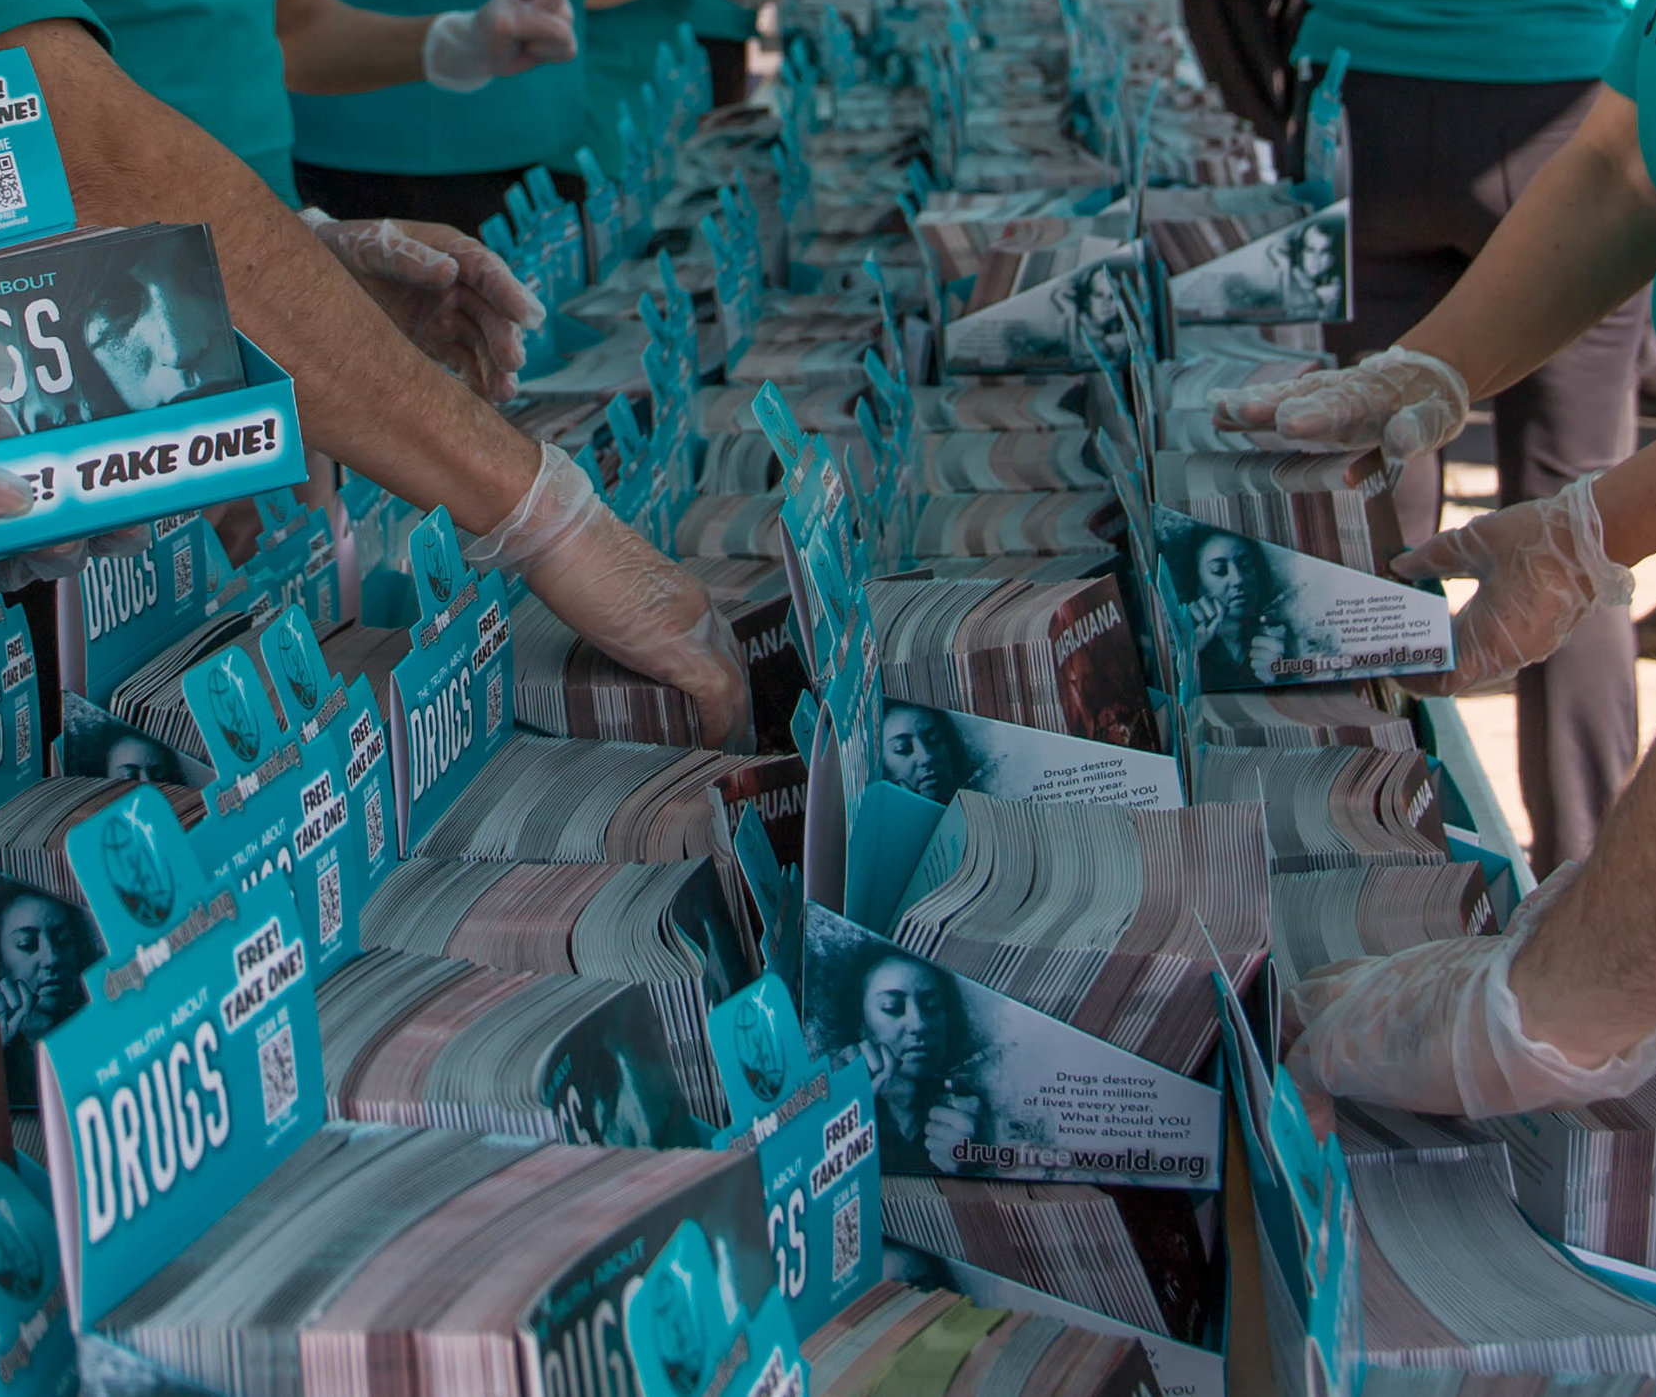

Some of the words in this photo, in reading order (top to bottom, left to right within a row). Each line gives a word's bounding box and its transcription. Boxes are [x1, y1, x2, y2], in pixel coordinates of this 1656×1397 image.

[76, 444, 179, 491] TAKE
[188, 418, 277, 466] ONE!
[83, 542, 158, 641] DRUGS
[1336, 597, 1365, 607] Drugs
[1367, 595, 1404, 605] destroy
[478, 603, 500, 639] FREE!
[1325, 608, 1343, 617] and
[1328, 617, 1350, 626] lives
[1352, 615, 1379, 625] every
[1341, 625, 1369, 635] What
[1371, 622, 1405, 632] should
[1408, 620, 1431, 628] YOU
[472, 641, 493, 672] TAKE
[493, 619, 510, 653] ONE!
[1341, 635, 1368, 644] know
[1370, 632, 1399, 641] about
[1401, 629, 1431, 639] them?
[1270, 645, 1444, 675] drugfreeworld.org
[350, 712, 373, 751] FREE!
[409, 666, 473, 802] DRUGS
[346, 753, 367, 787] TAKE
[367, 730, 385, 768] ONE!
[1044, 764, 1078, 779] Drugs
[1081, 758, 1123, 773] destroy
[303, 774, 332, 816] FREE!
[1032, 781, 1054, 792] and
[1057, 776, 1080, 787] ruin
[1083, 769, 1128, 784] millions
[1036, 790, 1062, 803] lives
[1065, 786, 1096, 799] every
[1098, 781, 1127, 795] year.
[1131, 784, 1159, 797] YOU
[261, 817, 287, 849] ABOUT
[294, 819, 323, 856] TAKE
[323, 792, 347, 834] ONE!
[237, 920, 282, 977] FREE!
[223, 978, 266, 1029] TAKE
[267, 942, 305, 995] ONE!
[125, 1022, 167, 1062] TRUTH
[170, 986, 209, 1029] ABOUT
[1039, 1083, 1066, 1095] and
[1070, 1085, 1098, 1097] ruin
[1102, 1086, 1158, 1100] millions
[1056, 1071, 1099, 1086] Drugs
[1102, 1074, 1156, 1088] destroy
[1023, 1096, 1040, 1107] of
[1042, 1096, 1073, 1109] lives
[1077, 1100, 1116, 1113] every
[1119, 1102, 1154, 1114] year.
[1061, 1111, 1100, 1124] What
[1104, 1112, 1154, 1126] should
[1158, 1115, 1192, 1127] YOU
[75, 1020, 230, 1245] DRUGS
[825, 1103, 859, 1152] FREE!
[1058, 1125, 1096, 1137] know
[1101, 1126, 1144, 1138] about
[1147, 1128, 1191, 1140] them?
[811, 1158, 844, 1195] TAKE
[845, 1123, 874, 1168] ONE!
[951, 1137, 1207, 1177] drugfreeworld.org
[773, 1157, 802, 1193] ABOUT
[1163, 1384, 1196, 1396] YOU
